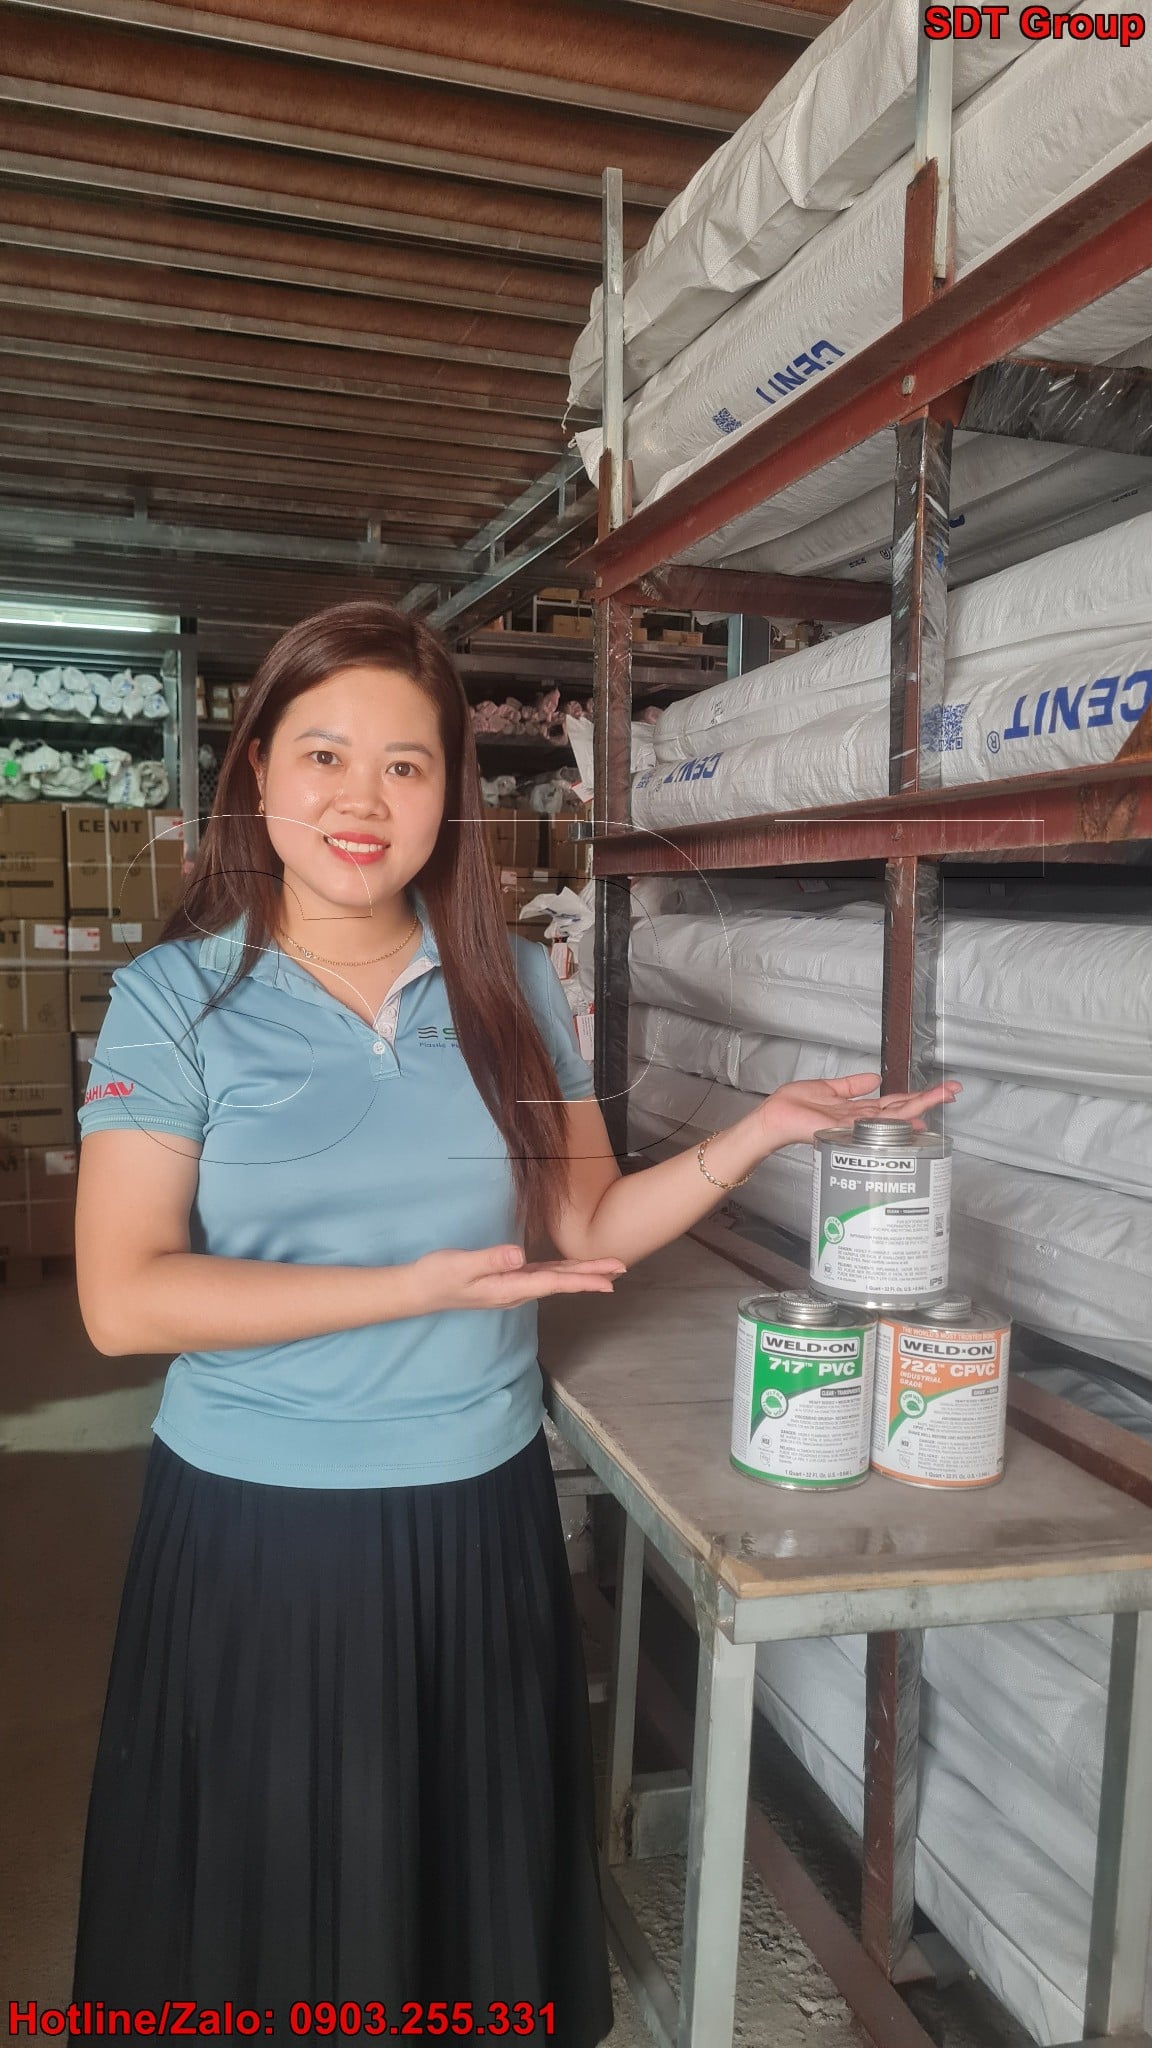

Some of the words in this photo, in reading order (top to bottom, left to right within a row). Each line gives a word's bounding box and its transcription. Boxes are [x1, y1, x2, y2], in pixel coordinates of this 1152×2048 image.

[79, 820, 142, 833] CENIT
[865, 1181, 916, 1194] PRIMER
[819, 1362, 855, 1376] PVC
[950, 1361, 995, 1377] CPVC
[899, 1379, 922, 1388] GRADE
[900, 1371, 942, 1383] INDUSTRIAL
